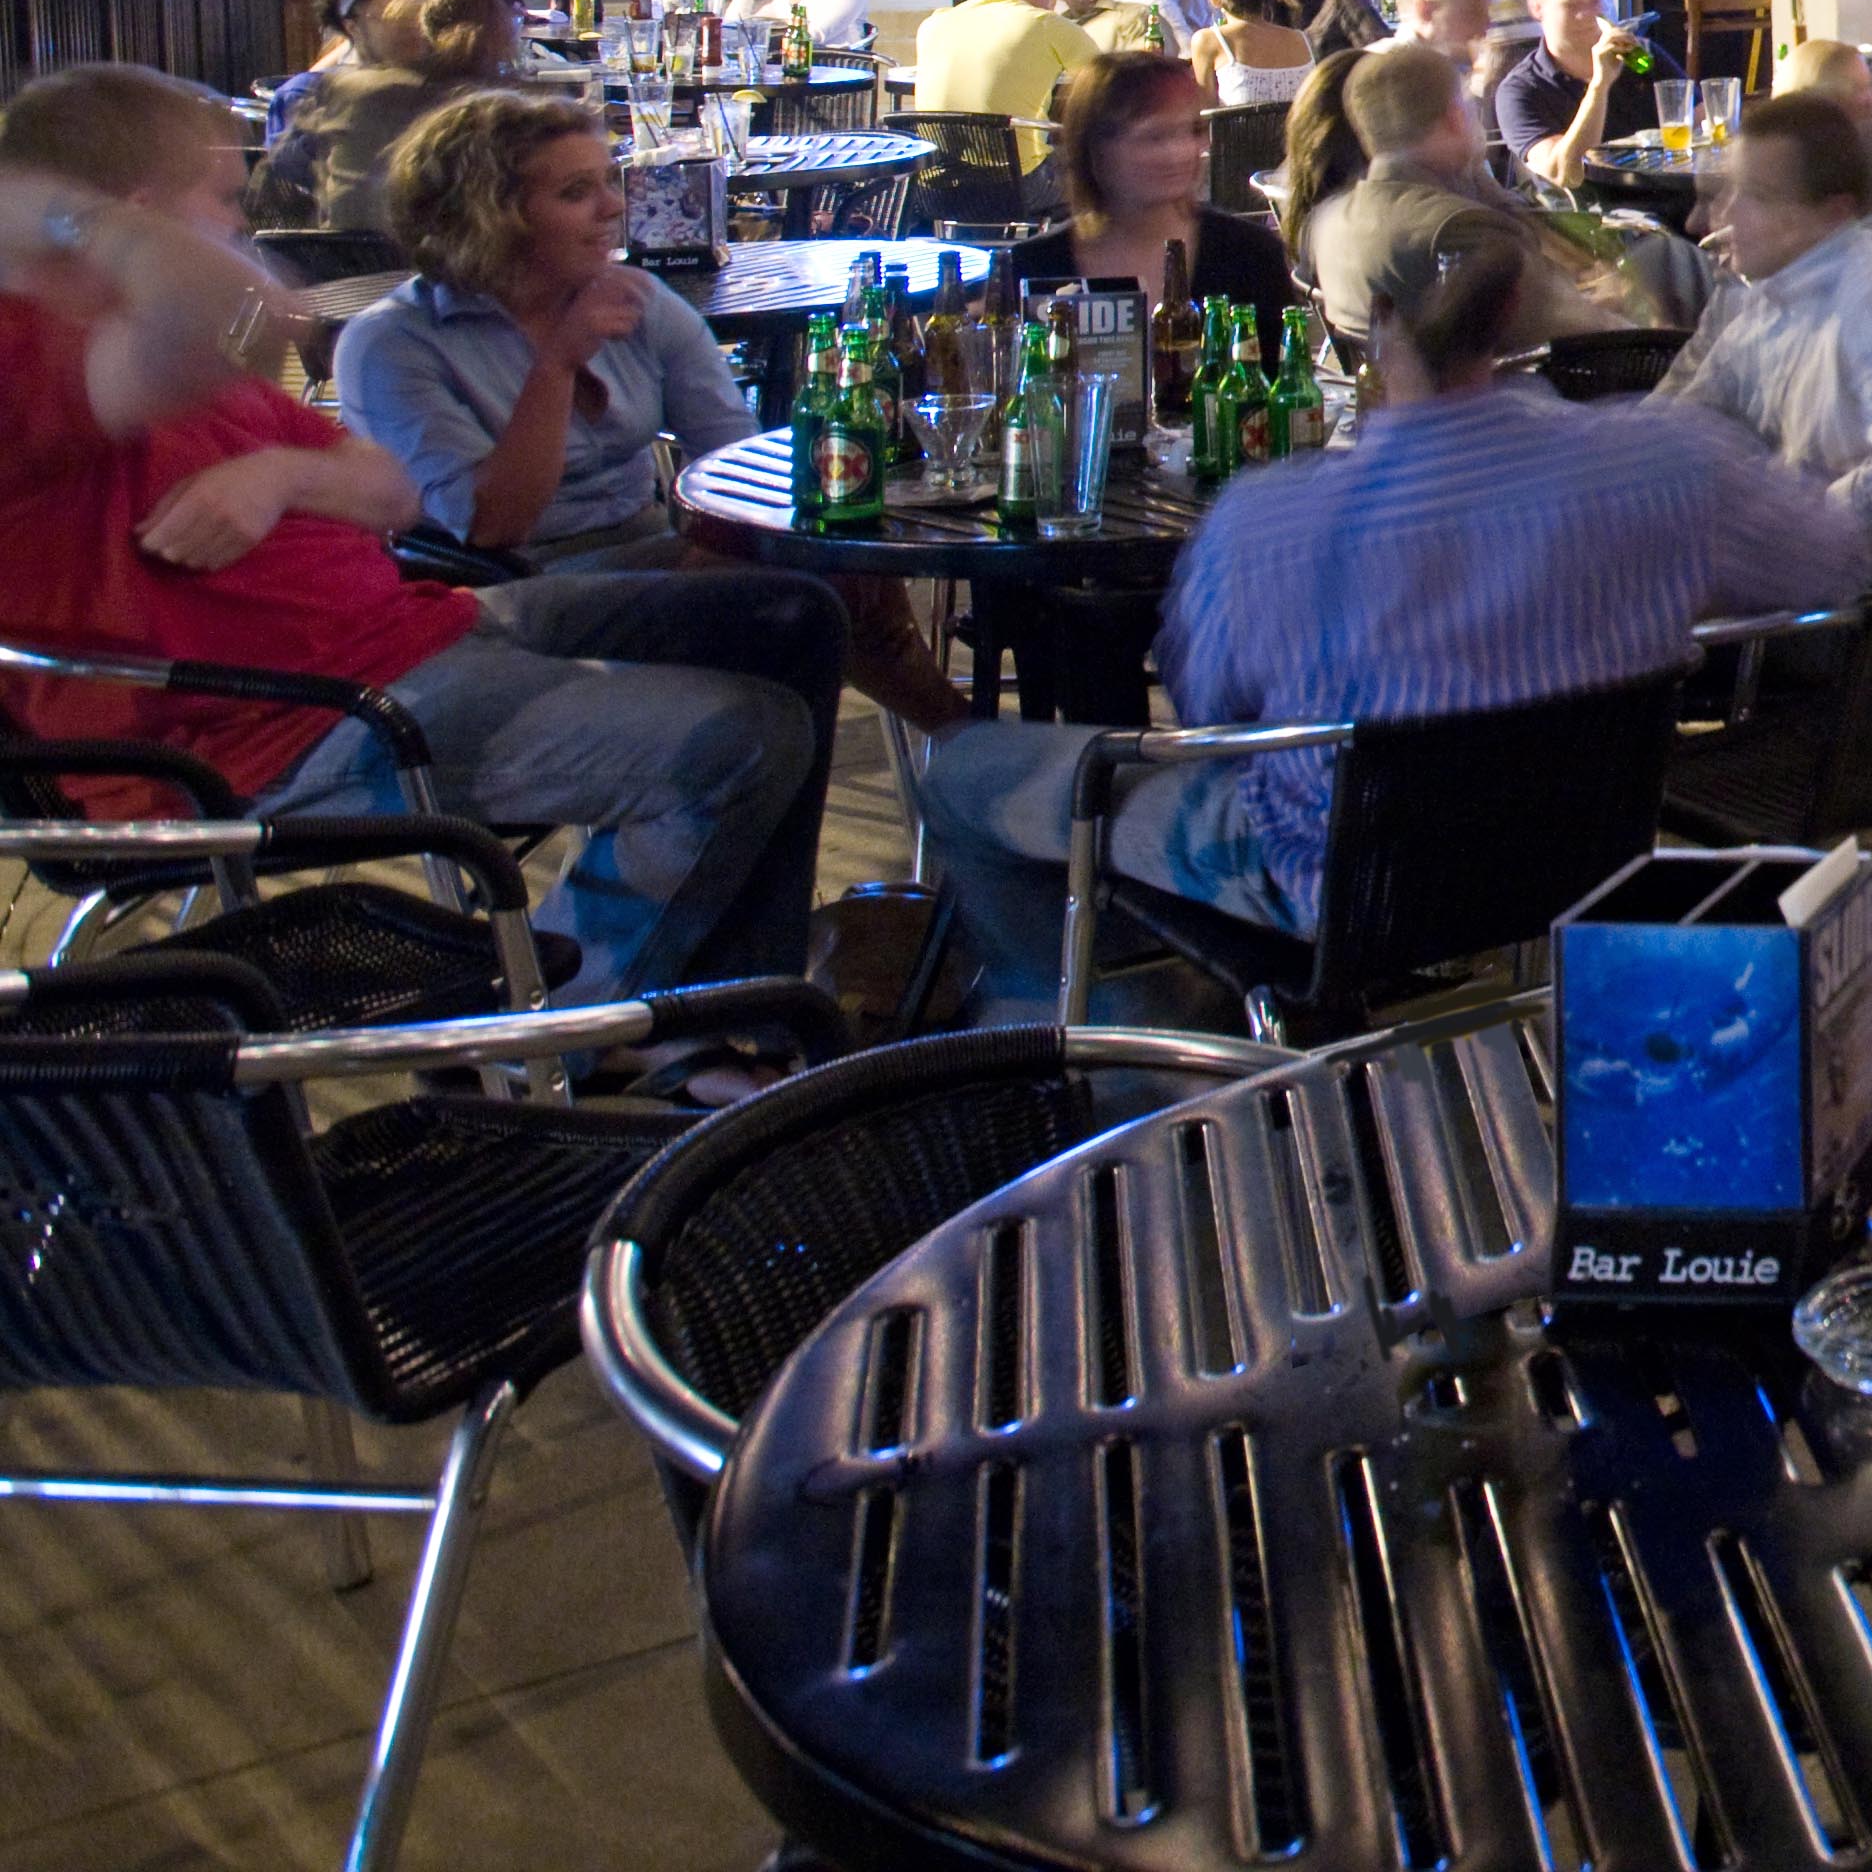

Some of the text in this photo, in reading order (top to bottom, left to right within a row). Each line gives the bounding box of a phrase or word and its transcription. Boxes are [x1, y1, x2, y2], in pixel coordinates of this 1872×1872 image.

[641, 256, 699, 267] Bar Louie
[1567, 1245, 1781, 1285] Bar Louie
